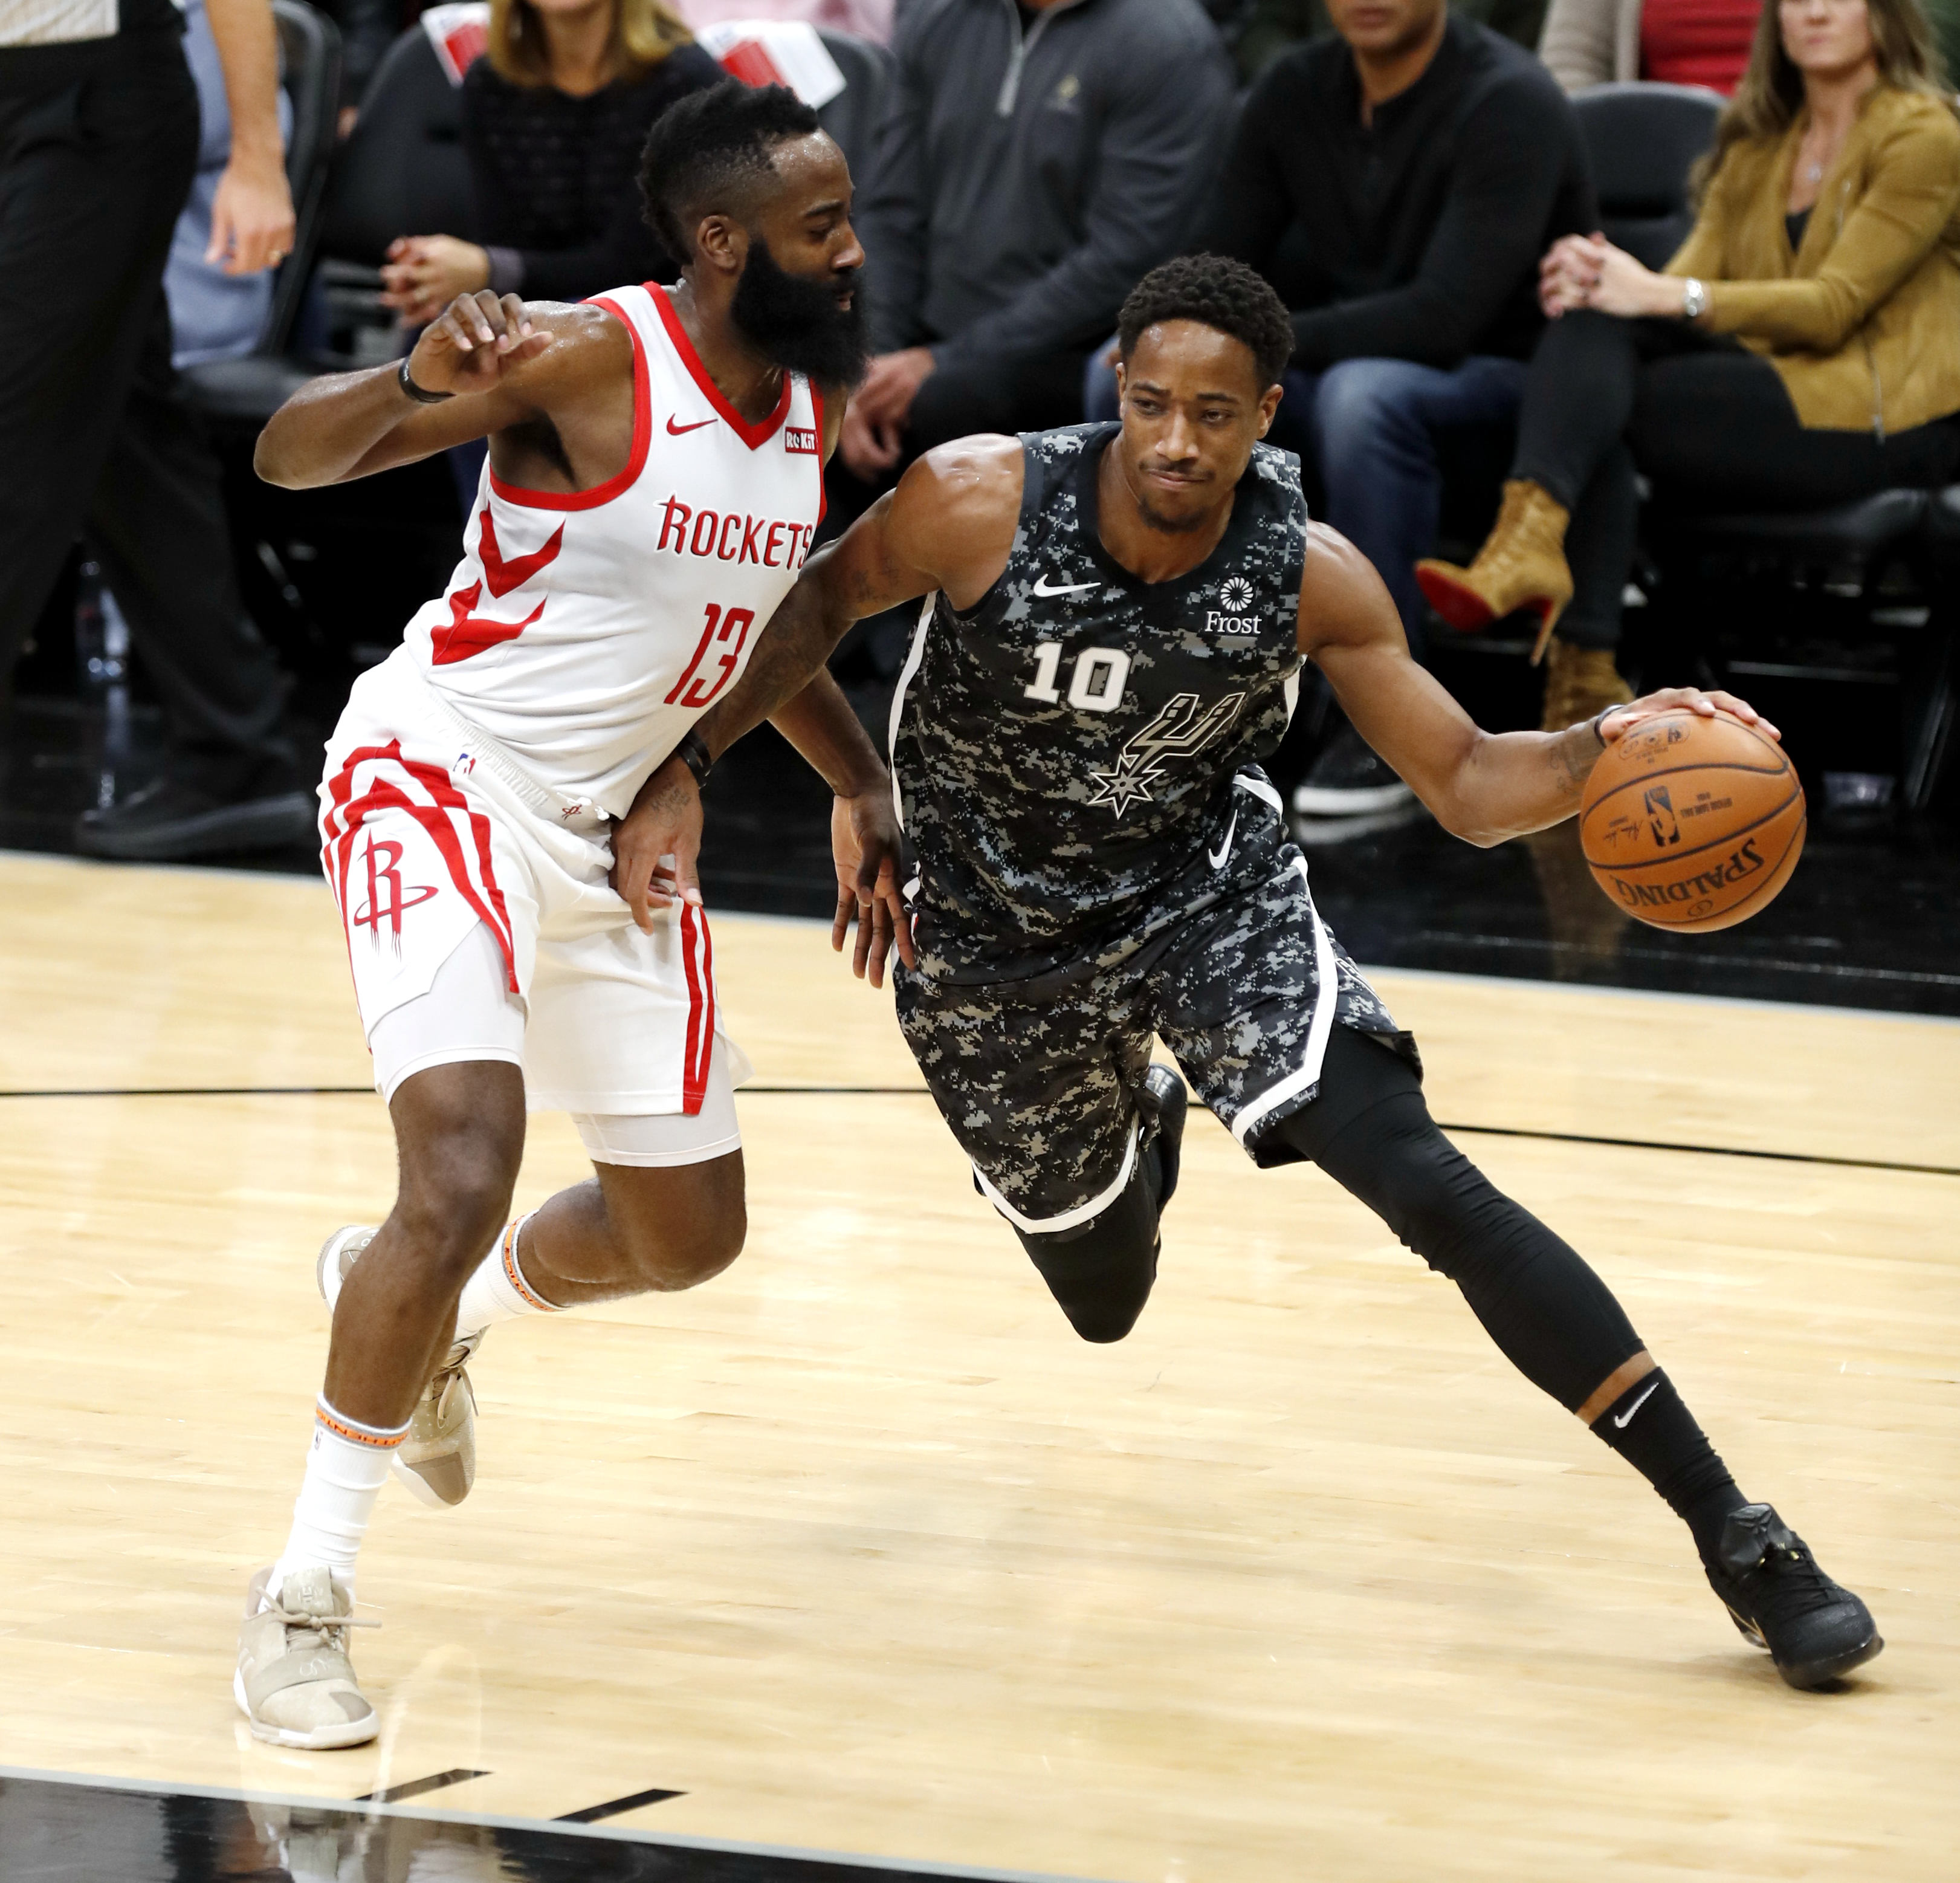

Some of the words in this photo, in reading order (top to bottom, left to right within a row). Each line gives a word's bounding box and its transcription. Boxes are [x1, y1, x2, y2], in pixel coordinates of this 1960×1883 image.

[656, 494, 813, 571] ROCKETS
[664, 603, 755, 708] 13
[1205, 611, 1262, 634] Frost
[1024, 641, 1132, 713] 10
[1609, 838, 1764, 906] SPALDING
